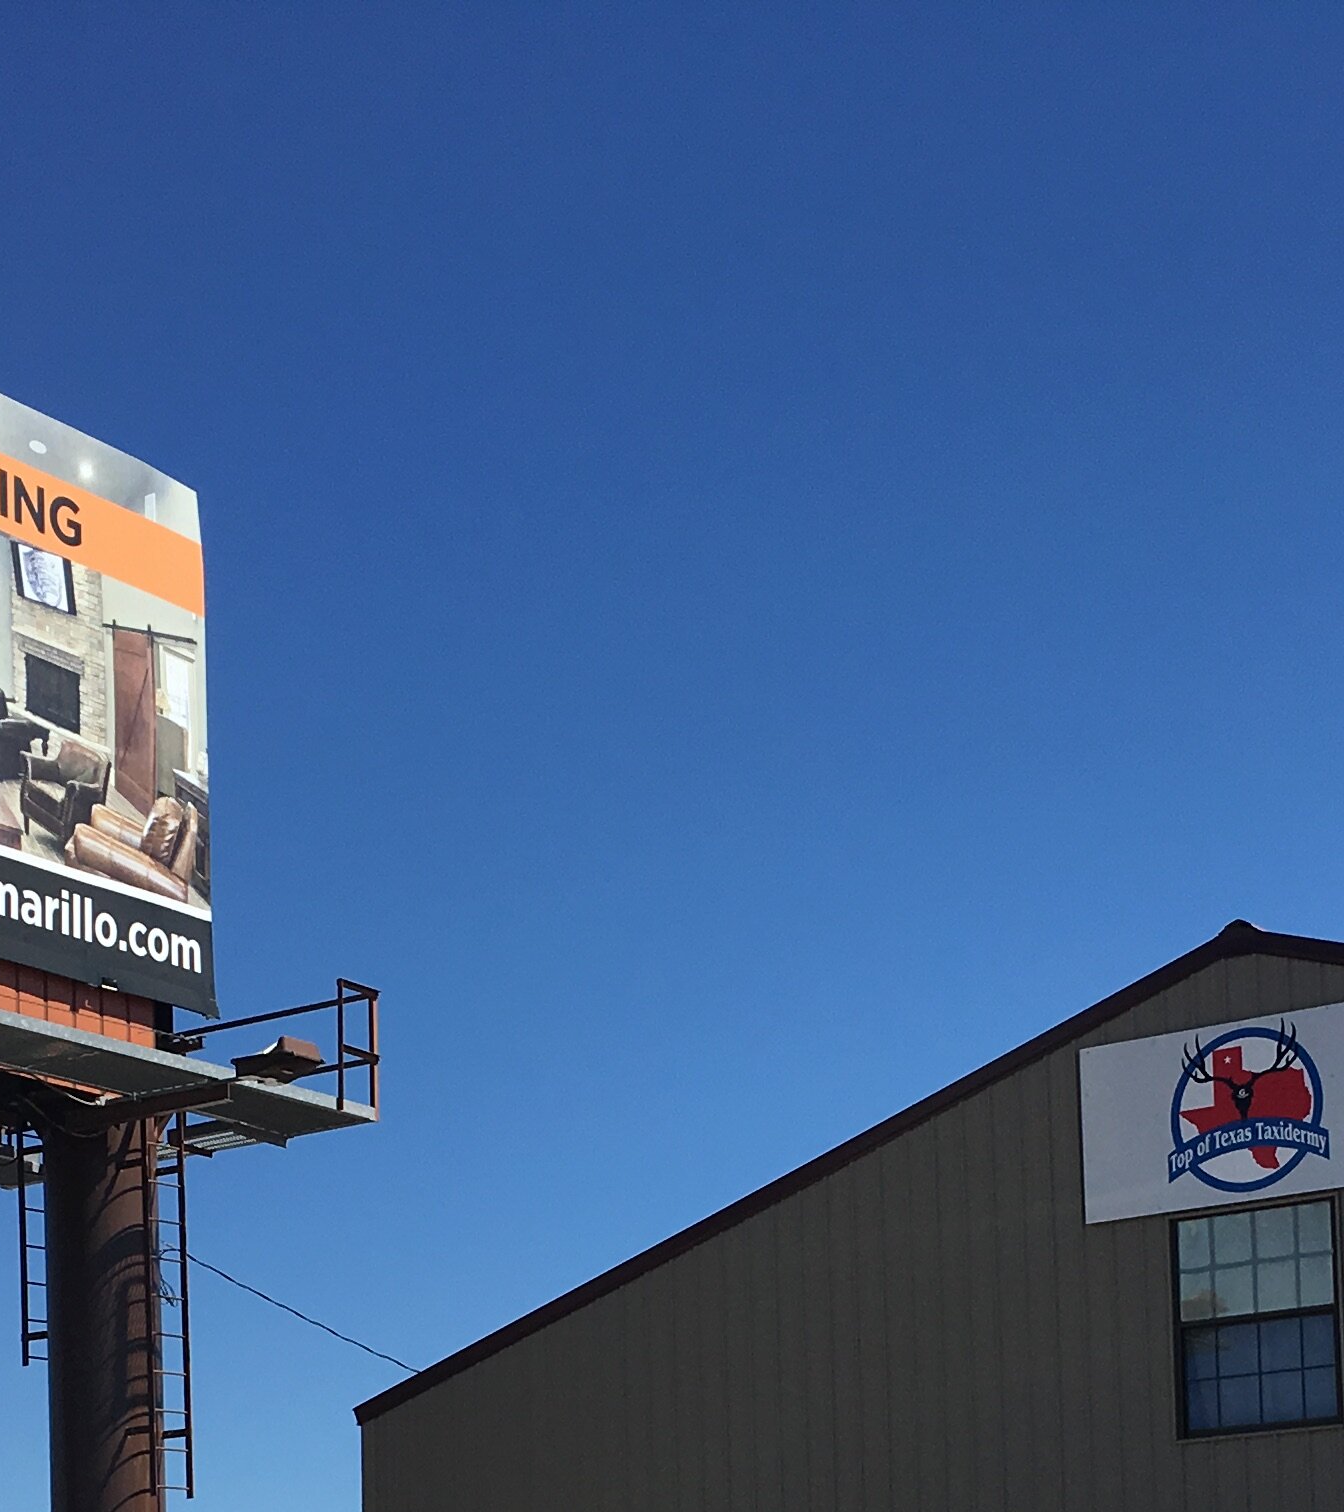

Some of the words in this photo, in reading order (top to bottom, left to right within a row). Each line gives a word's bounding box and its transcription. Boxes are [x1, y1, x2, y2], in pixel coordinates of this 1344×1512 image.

[1169, 1149, 1194, 1172] Top
[1197, 1134, 1210, 1157] of
[1213, 1127, 1252, 1149] Texas
[1256, 1121, 1327, 1154] Taxidermy
